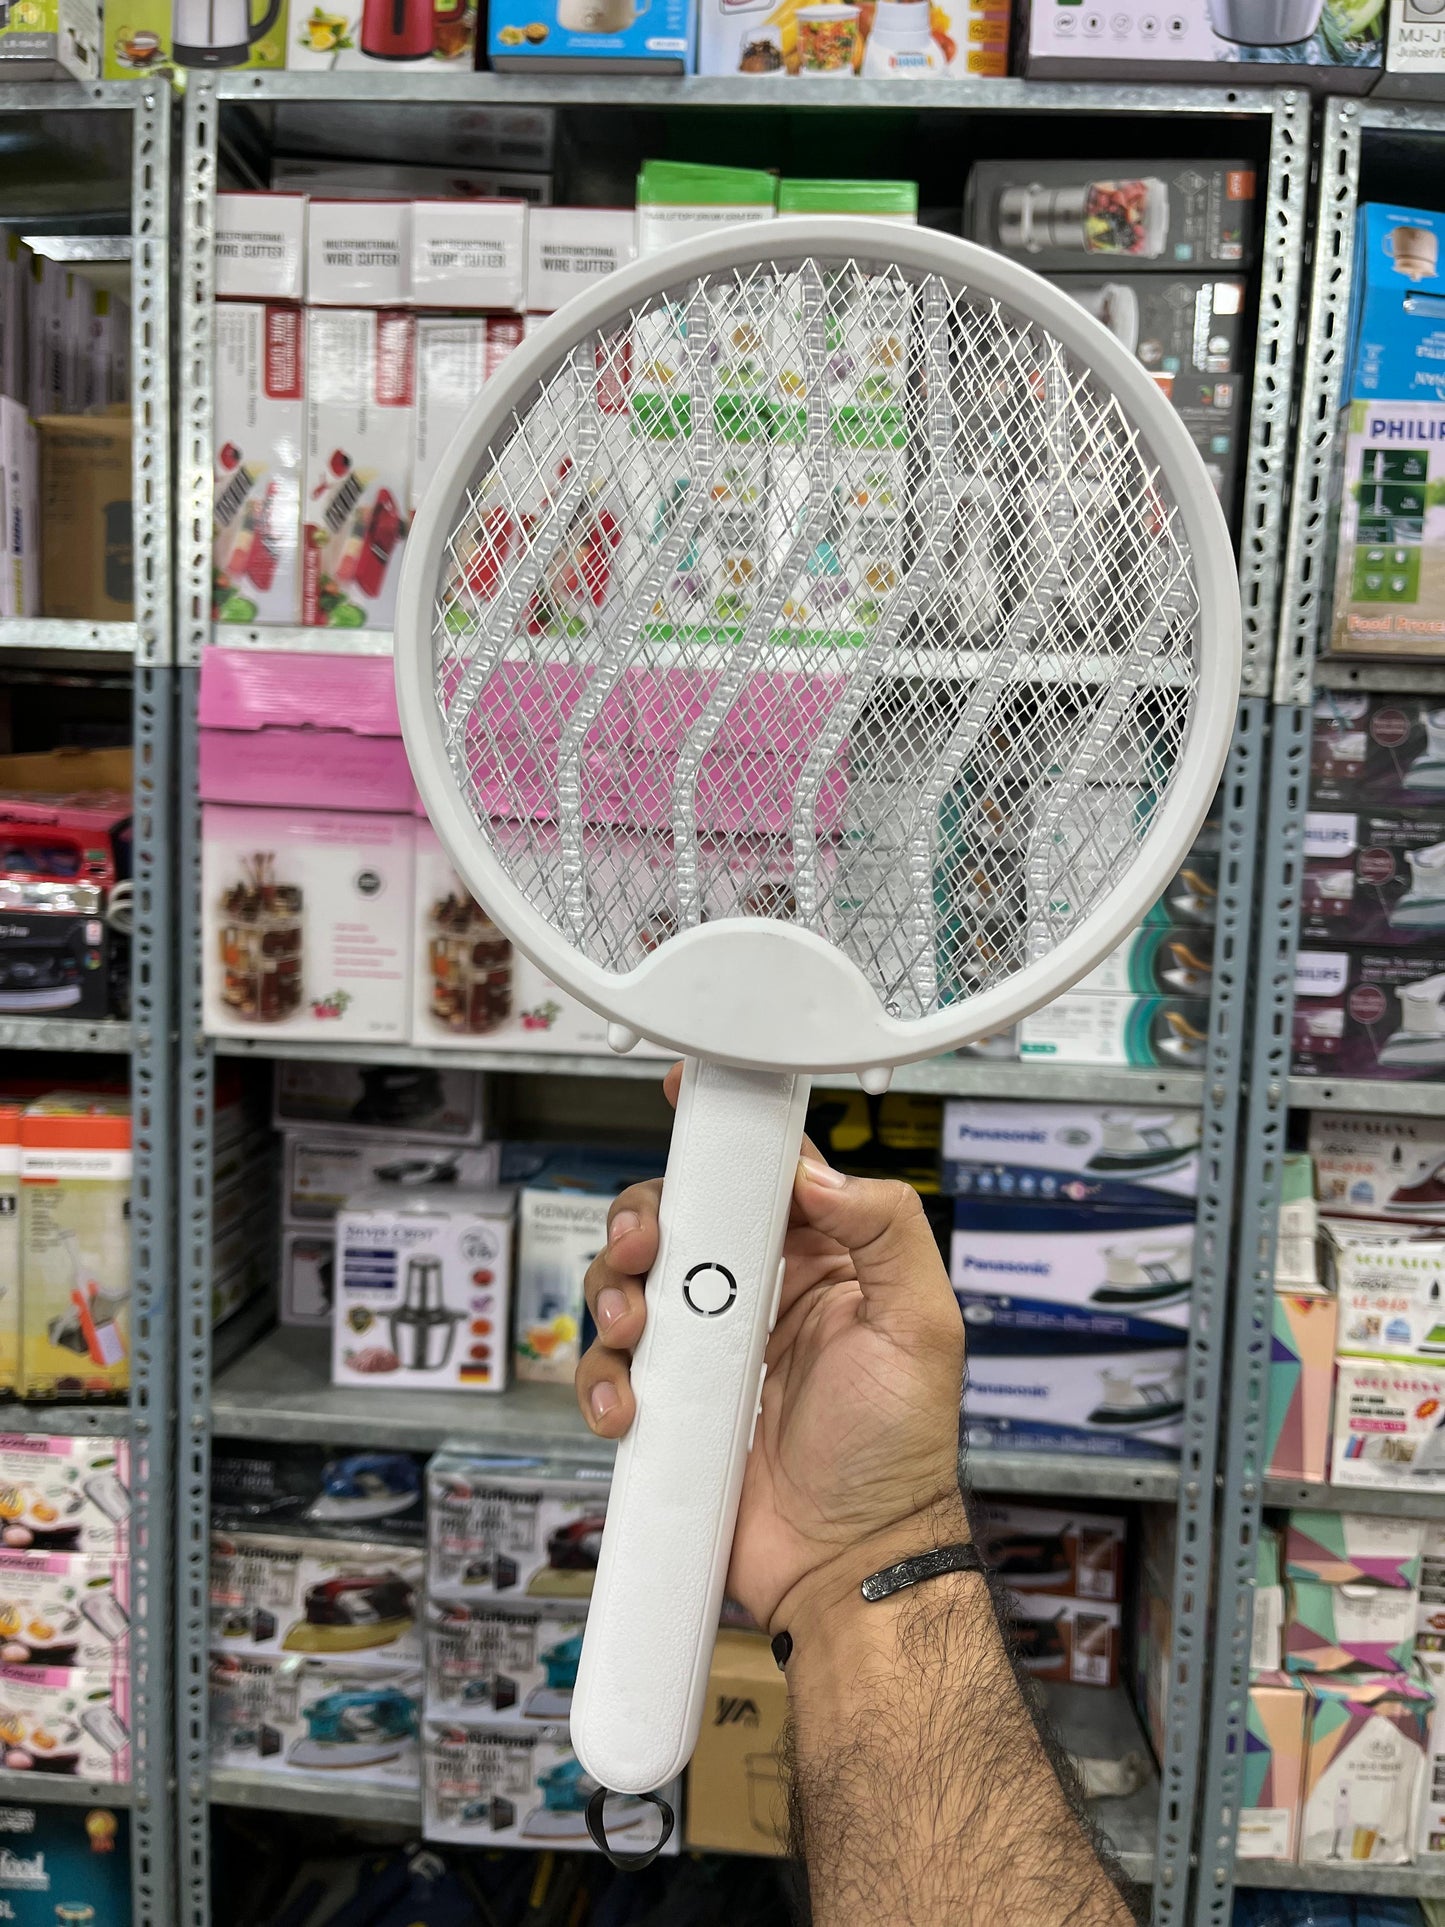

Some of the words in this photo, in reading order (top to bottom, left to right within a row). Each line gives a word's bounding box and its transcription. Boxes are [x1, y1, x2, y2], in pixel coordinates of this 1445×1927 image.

[215, 243, 239, 257] WIRE
[243, 245, 283, 259] CUTTER
[326, 252, 351, 266] WIRE
[356, 253, 400, 267] CUTTER
[430, 252, 458, 267] WIRE
[463, 253, 507, 269] CUTTER
[541, 258, 571, 273] WIRE
[575, 260, 618, 274] CUTTER
[959, 1124, 1048, 1143] Panasonic
[533, 1203, 608, 1223] KENWOO
[963, 1255, 1051, 1276] Panasonic
